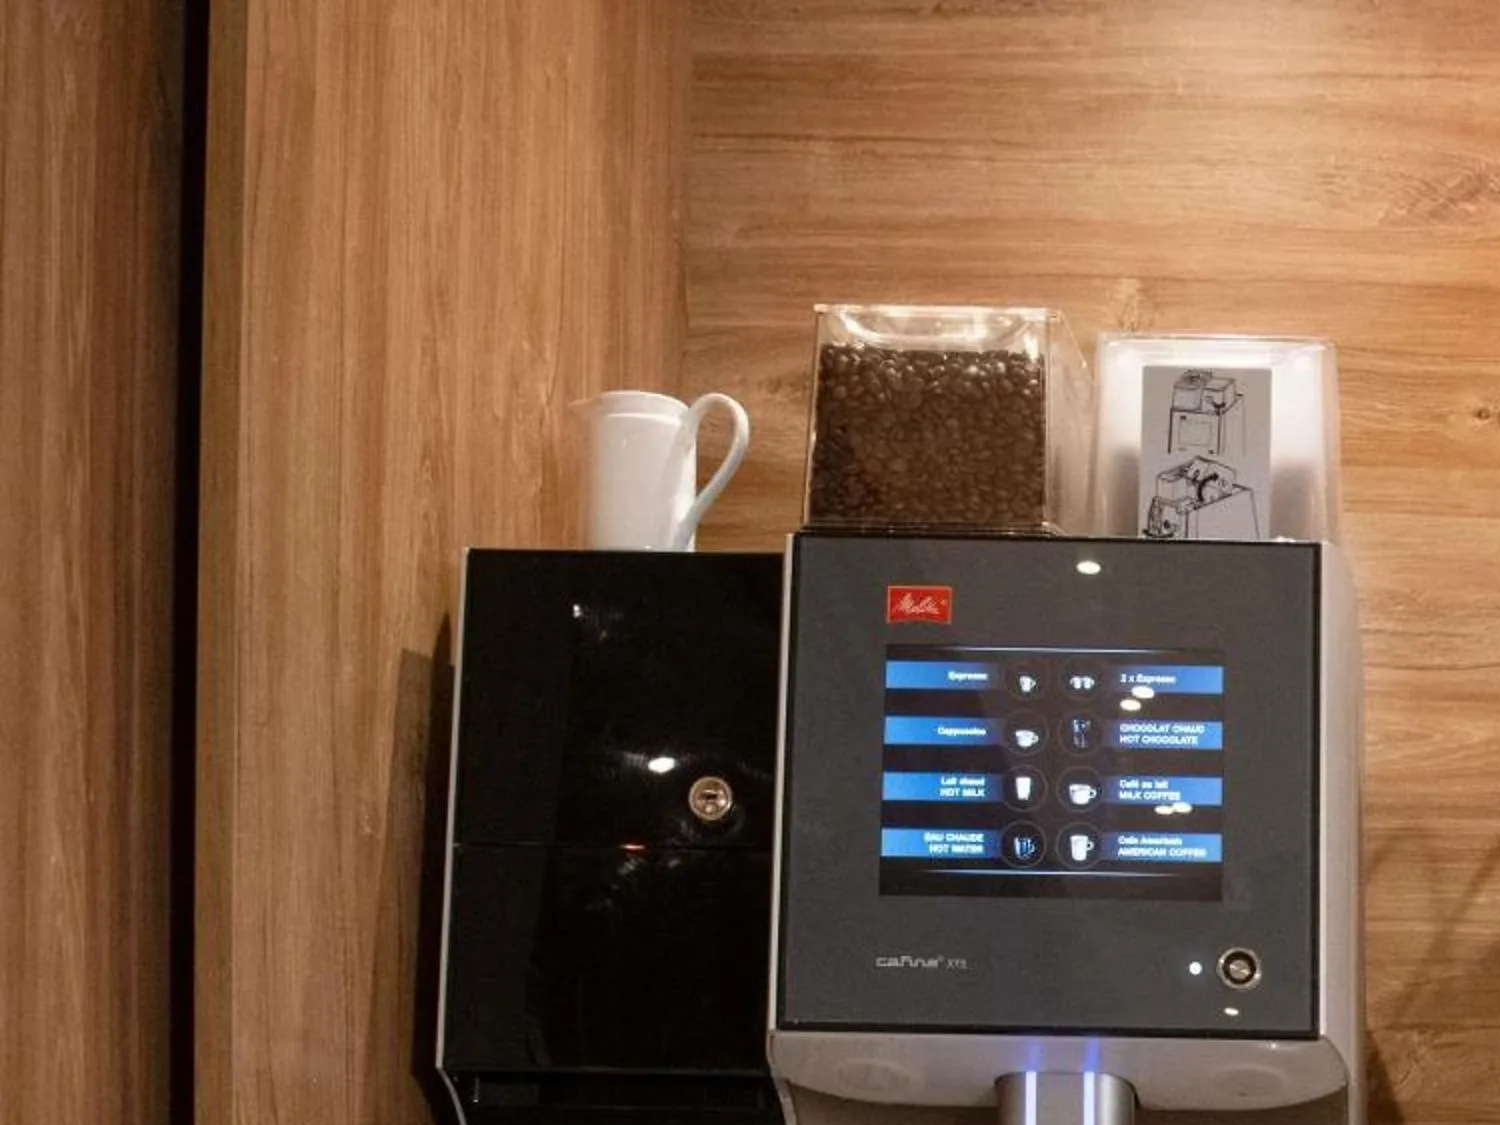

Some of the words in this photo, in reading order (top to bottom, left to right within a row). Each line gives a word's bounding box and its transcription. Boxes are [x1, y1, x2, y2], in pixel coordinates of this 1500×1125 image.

[1119, 723, 1170, 733] CHOCOLAT
[1119, 734, 1140, 744] HOT
[1141, 735, 1198, 745] CHOCOLATE
[939, 787, 960, 797] HOT
[961, 787, 985, 797] MILK
[1119, 790, 1142, 800] MILK
[1143, 791, 1181, 801] COFFEE
[945, 832, 984, 843] CHAUDE
[928, 844, 950, 854] HOT
[951, 844, 984, 854] WATER
[1118, 847, 1167, 857] AMERICAN
[1168, 848, 1208, 858] COFFEE
